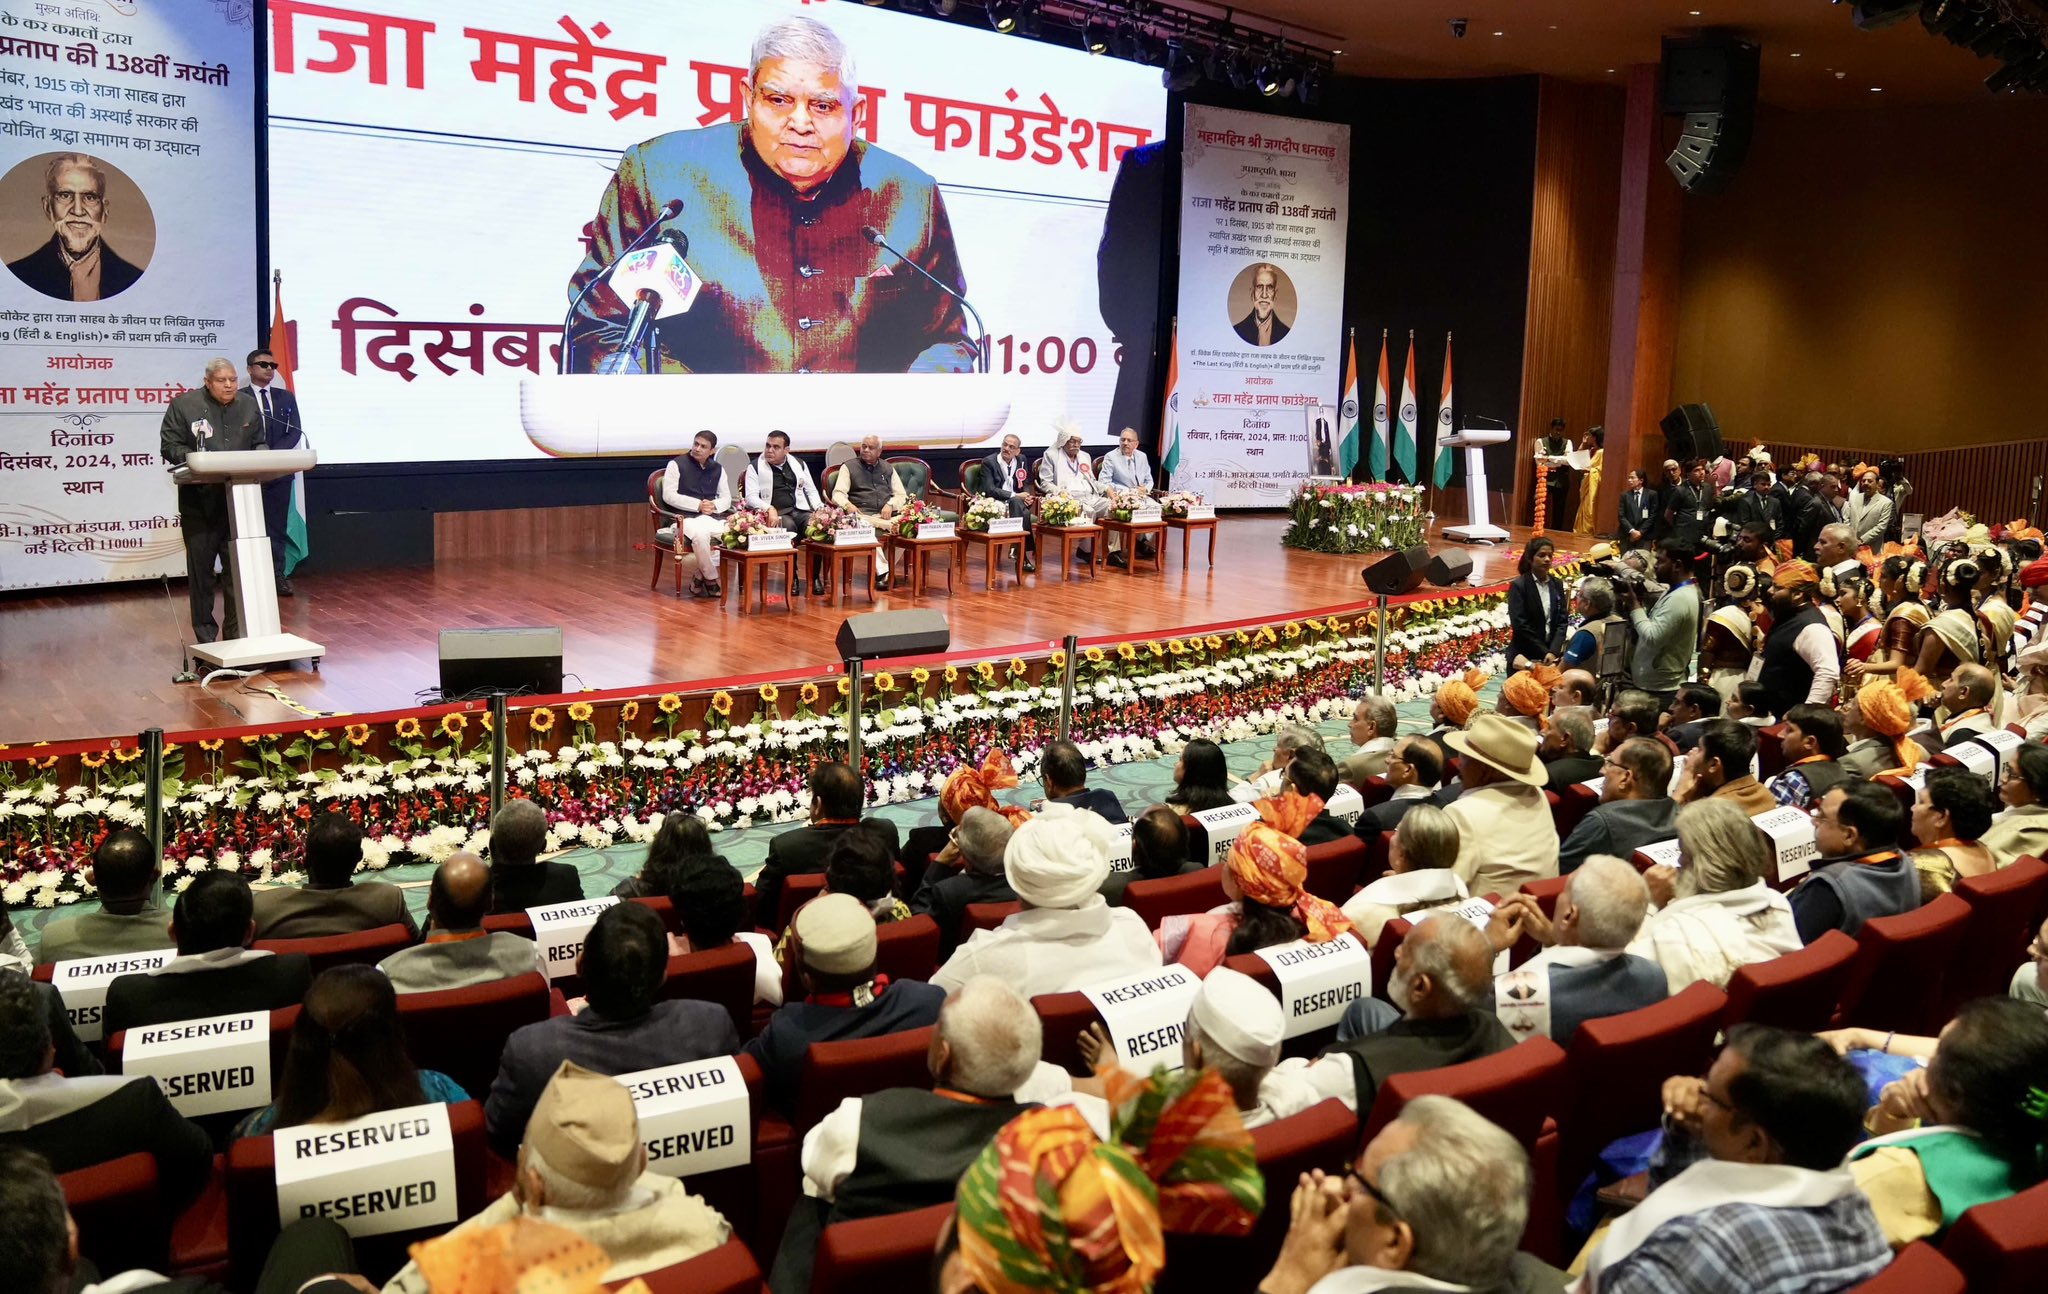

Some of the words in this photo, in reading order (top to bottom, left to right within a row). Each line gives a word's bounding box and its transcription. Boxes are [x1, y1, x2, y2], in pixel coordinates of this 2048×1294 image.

[34, 2, 60, 16] मुख्य
[1, 11, 19, 26] के
[23, 19, 49, 31] कर
[52, 23, 99, 40] कमलों
[102, 31, 134, 46] द्वारा
[65, 42, 99, 68] की
[105, 53, 170, 78] 138वीं
[173, 61, 230, 86] जयंती
[269, 0, 436, 90] ाजा
[463, 15, 667, 121] महेंद्र
[34, 76, 66, 91] 1915
[70, 78, 91, 95] को
[93, 84, 121, 99] राजा
[124, 88, 159, 104] साहब
[162, 93, 186, 108] द्वारा
[28, 100, 63, 117] भारत
[66, 103, 87, 119] की
[90, 108, 133, 126] अस्थाई
[136, 114, 178, 131] सरकार
[181, 117, 199, 133] की
[49, 128, 79, 146] श्रद्धा
[83, 132, 129, 149] समागम
[133, 138, 151, 151] का
[1247, 133, 1261, 148] श्री
[1263, 137, 1300, 153] जगदीप
[1192, 196, 1212, 208] राजा
[1215, 196, 1236, 211] महेंद्र
[1238, 201, 1263, 213] प्रताप
[1265, 201, 1279, 215] की
[1282, 204, 1310, 218] 138वीं
[1311, 207, 1336, 221] जयंती
[33, 313, 52, 323] द्वारा
[56, 314, 76, 323] राजा
[79, 314, 105, 324] साहब
[108, 313, 119, 324] के
[121, 314, 146, 326] जीवन
[150, 317, 161, 326] पर
[164, 315, 195, 327] लिखित
[198, 319, 225, 330] पुस्तक
[13, 327, 40, 341] (हिंदी
[44, 330, 52, 340] &
[112, 330, 125, 341] की
[129, 333, 151, 342] प्रथम
[154, 332, 171, 343] प्रति
[174, 332, 186, 343] की
[190, 333, 217, 346] प्रस्तुति
[331, 297, 562, 382] दिसंब
[47, 353, 113, 370] आयोजक
[23, 382, 70, 406] महेंद्र
[76, 387, 129, 405] प्रताप
[1213, 393, 1232, 404] राजा
[1234, 391, 1254, 405] महेंद्र
[1256, 395, 1279, 405] प्रताप
[1243, 418, 1271, 429] दिनांक
[50, 429, 115, 447] दिनांक
[1248, 433, 1271, 442] 2024,
[65, 454, 116, 470] 2024,
[1246, 448, 1264, 456] स्थान
[62, 481, 104, 496] स्थान
[32, 523, 71, 536] भारत
[128, 515, 169, 531] प्रगति
[24, 540, 49, 555] नई
[52, 537, 95, 554] दिल्ली
[101, 537, 143, 550] 110001
[1204, 807, 1251, 823] RESERVED
[68, 957, 163, 978] RESERVED
[1102, 973, 1186, 1005] RESERVED
[1293, 981, 1361, 1017] RESERVED
[141, 1019, 254, 1045] RESERVED
[295, 1118, 430, 1159] RESERVED
[643, 1124, 734, 1162] SERVED
